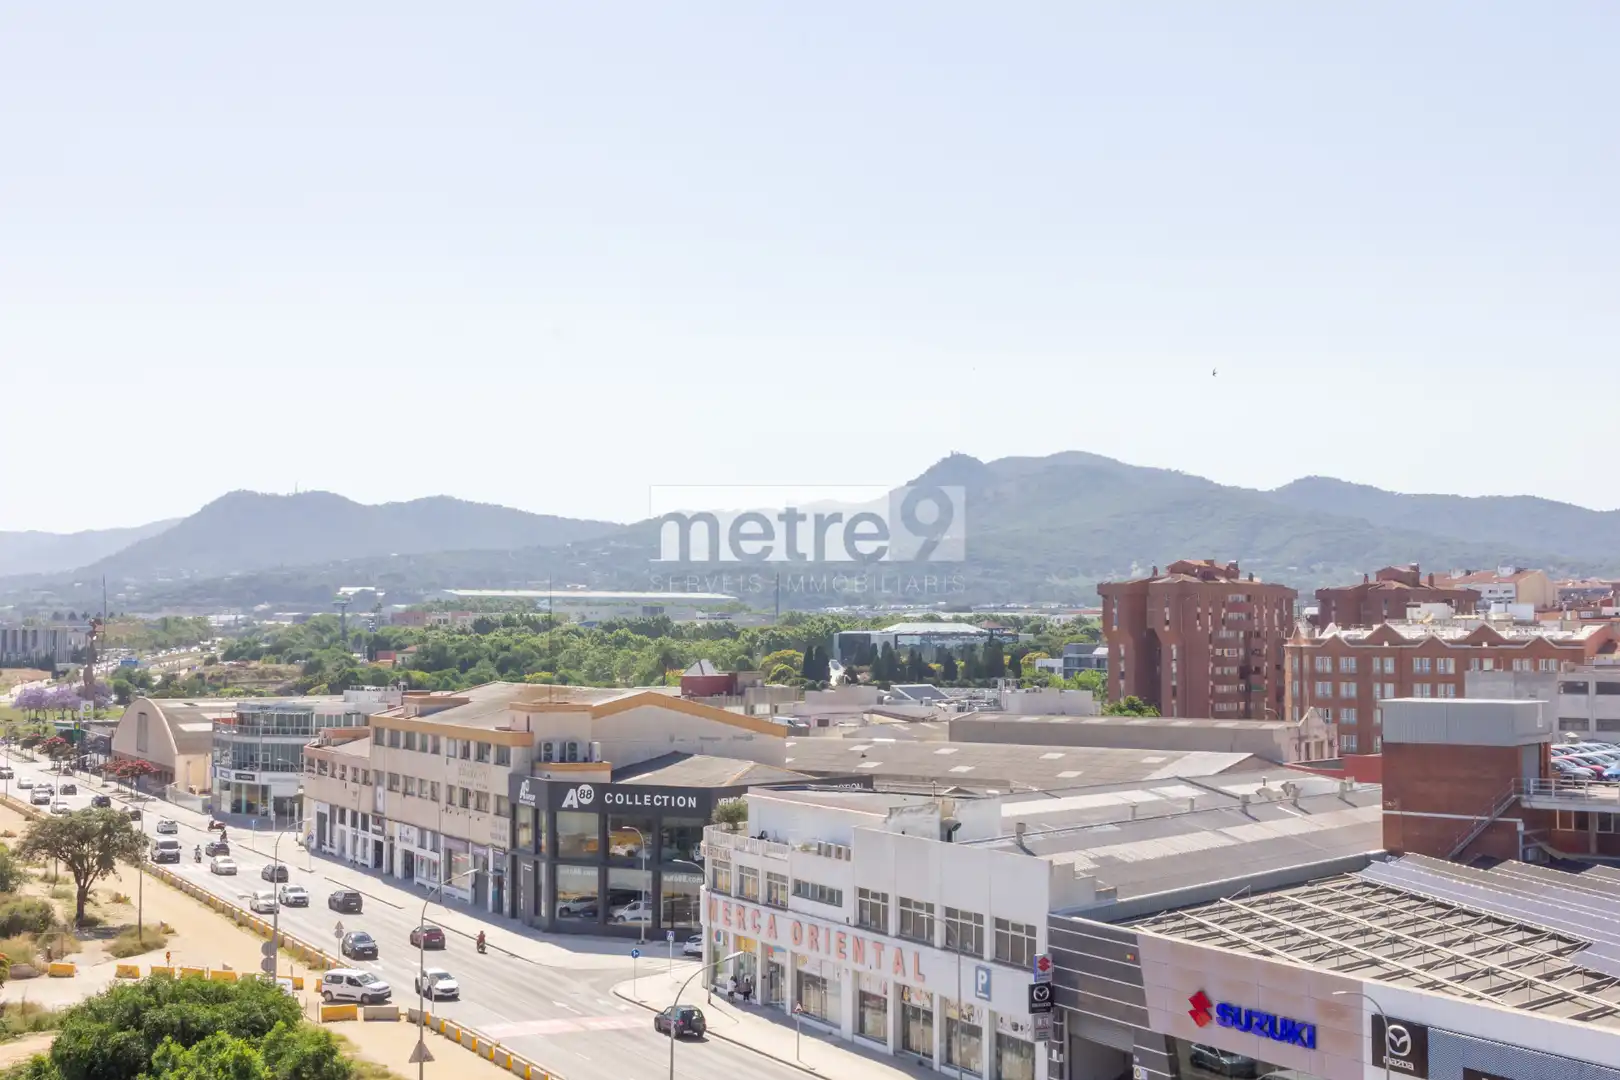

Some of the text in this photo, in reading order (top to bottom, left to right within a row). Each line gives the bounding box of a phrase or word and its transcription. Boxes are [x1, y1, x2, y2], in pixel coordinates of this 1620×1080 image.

[604, 793, 697, 808] COLLECTION
[707, 896, 926, 982] MERCA ORIENTAL
[1216, 1002, 1316, 1049] SUZUKI
